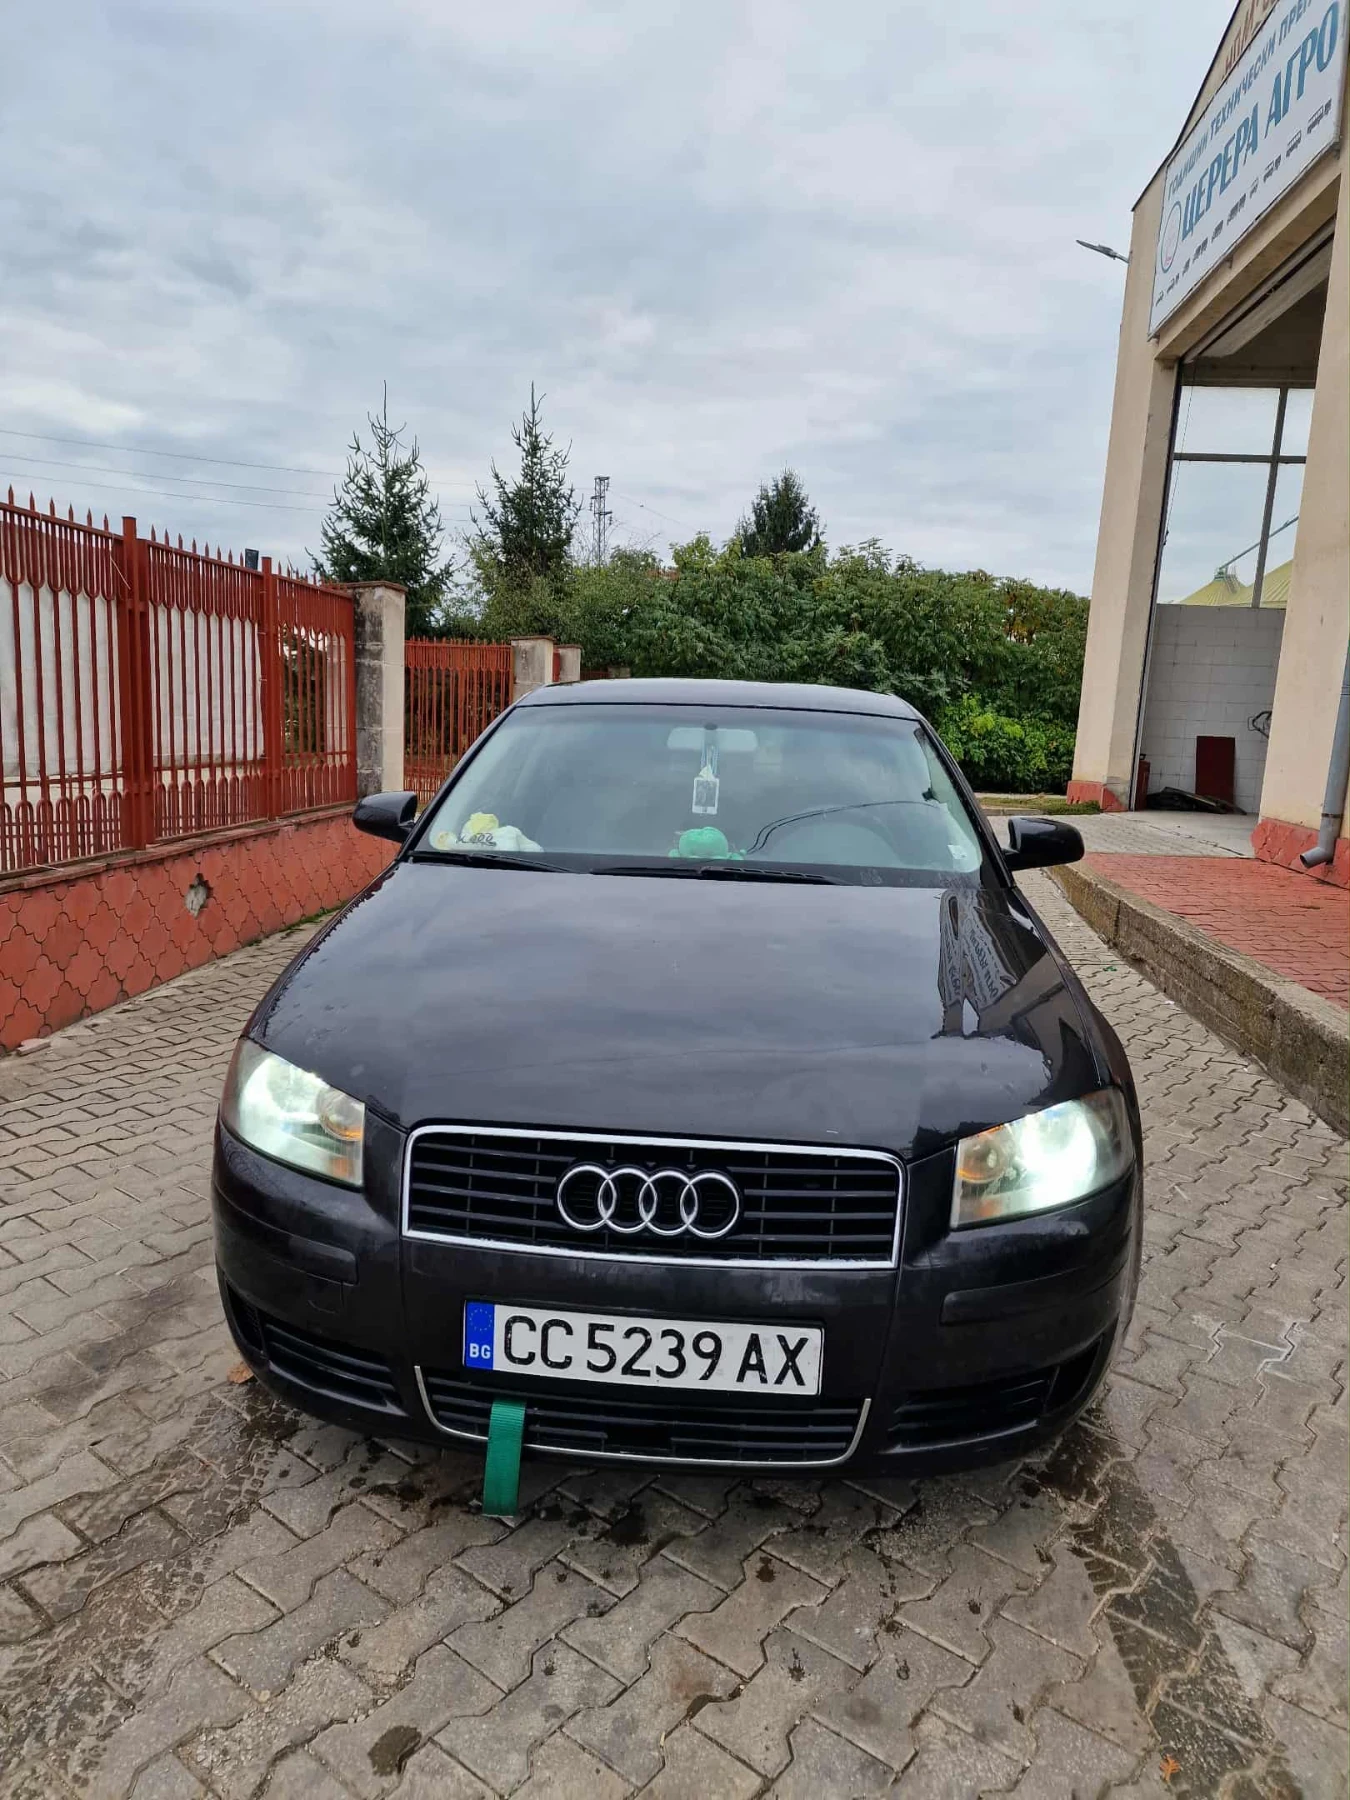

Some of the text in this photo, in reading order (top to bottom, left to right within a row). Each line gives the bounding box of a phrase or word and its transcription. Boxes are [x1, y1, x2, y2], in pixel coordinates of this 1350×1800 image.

[1181, 102, 1259, 241] ЦЕРЕРА
[1265, 1, 1339, 139] АГРО
[1210, 29, 1276, 140] ТЕХНИЧЕСКИ
[469, 1343, 491, 1360] BG
